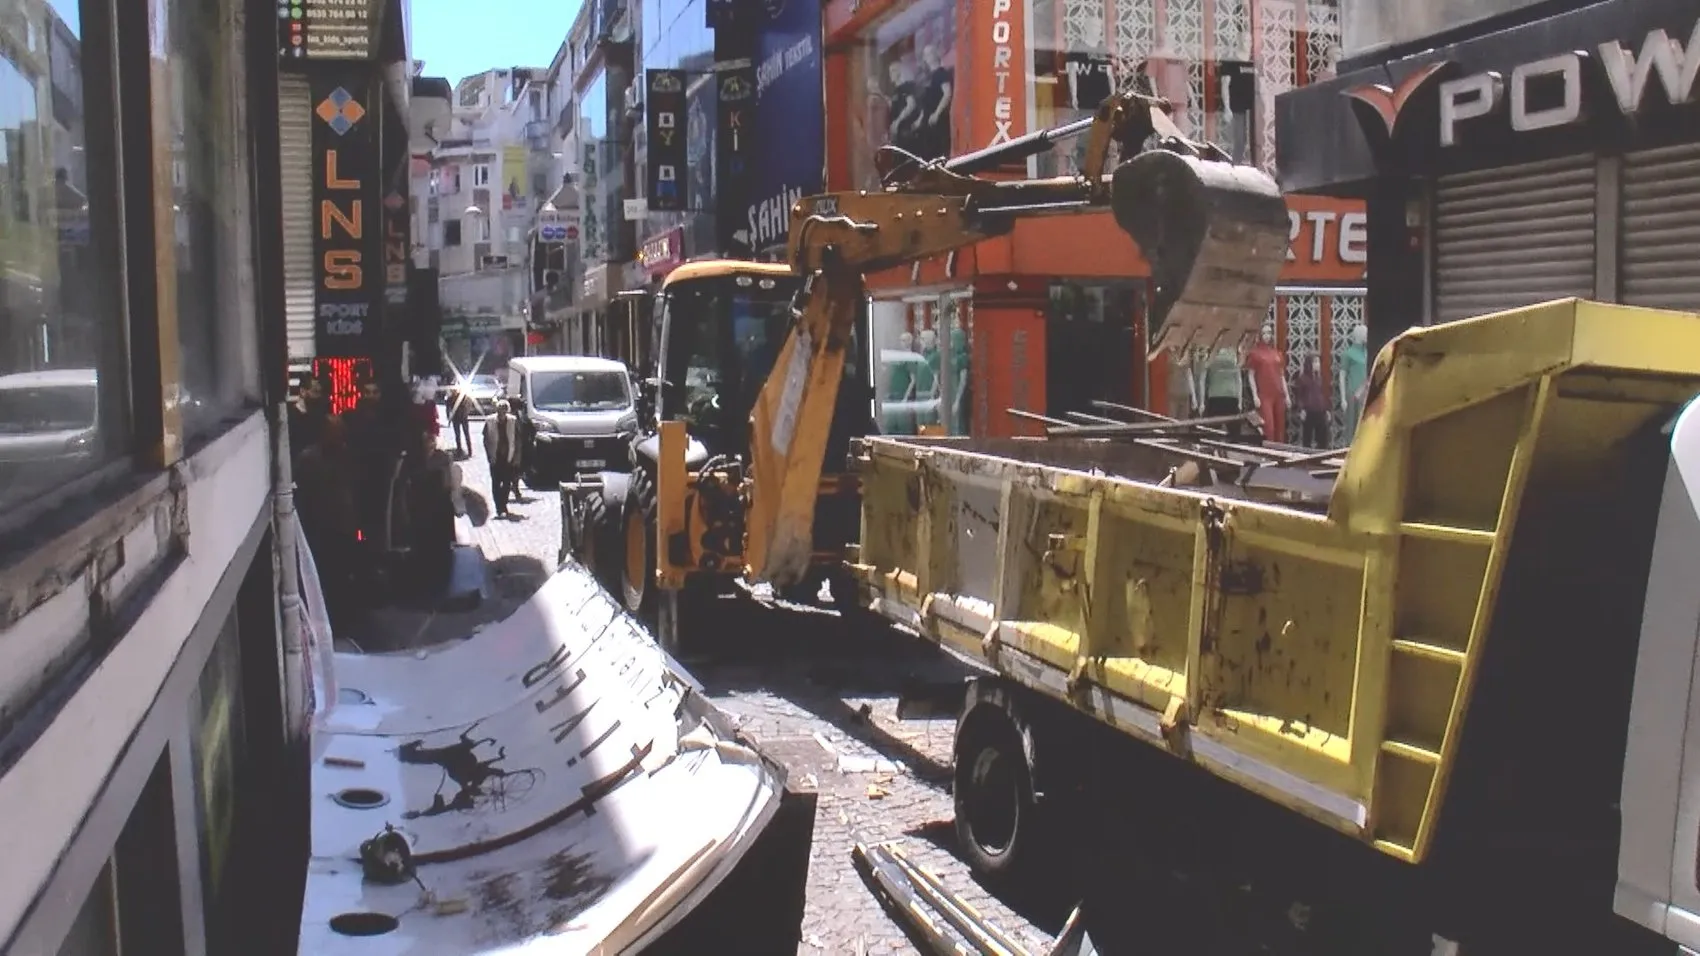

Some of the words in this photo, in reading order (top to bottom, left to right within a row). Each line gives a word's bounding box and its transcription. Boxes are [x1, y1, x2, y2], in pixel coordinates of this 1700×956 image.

[987, 0, 1012, 148] PORTEX
[1440, 17, 1700, 147] POW
[322, 149, 362, 289] LNS
